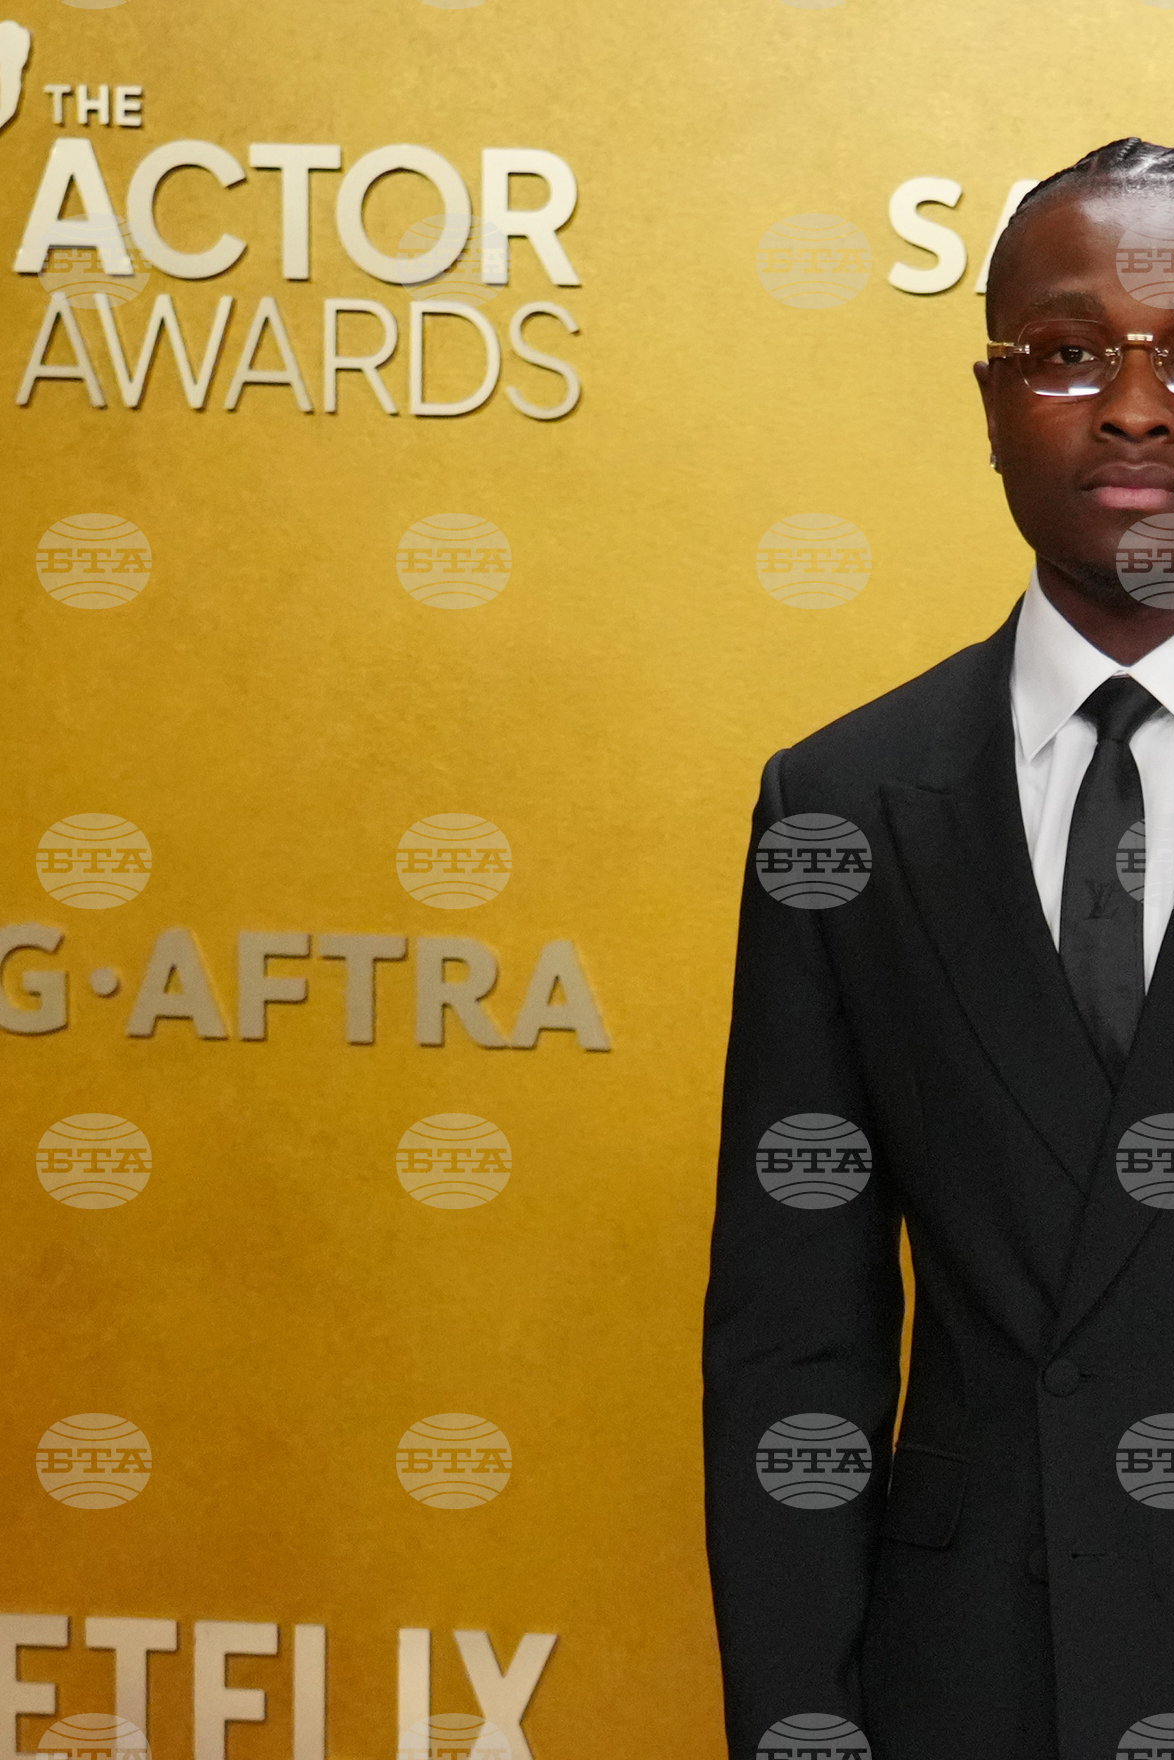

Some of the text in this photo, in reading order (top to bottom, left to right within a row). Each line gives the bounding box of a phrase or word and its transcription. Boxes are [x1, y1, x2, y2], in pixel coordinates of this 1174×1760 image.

[44, 84, 143, 129] THE
[13, 136, 581, 286] ACTOR
[15, 290, 581, 421] AWARDS
